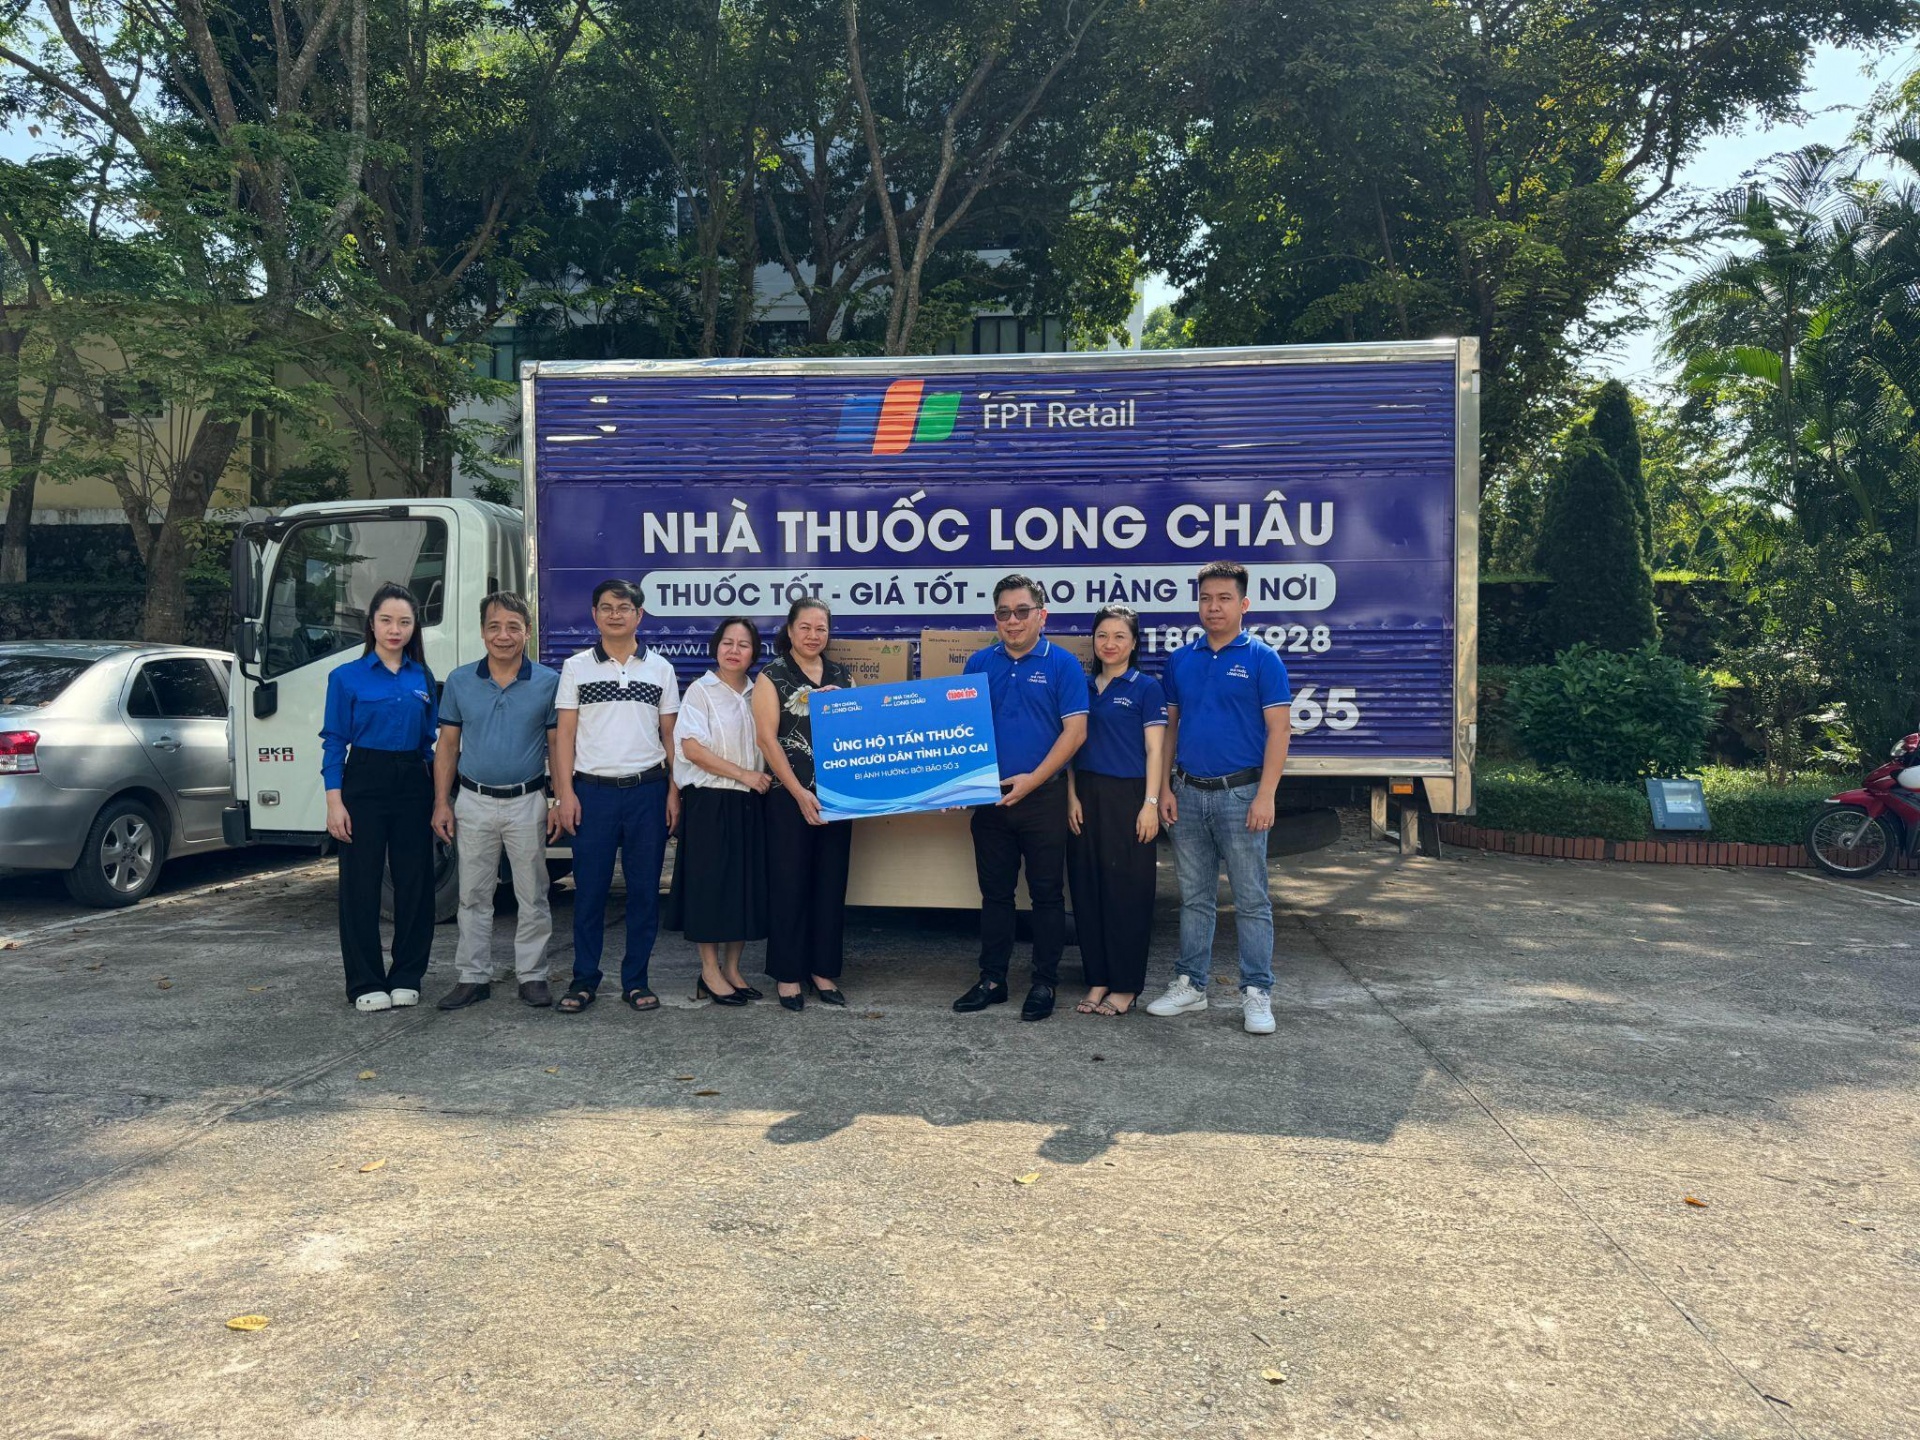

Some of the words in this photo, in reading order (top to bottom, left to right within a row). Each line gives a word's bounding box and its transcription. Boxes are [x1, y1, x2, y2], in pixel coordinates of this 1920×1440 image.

[983, 402, 1040, 429] FPT
[1048, 399, 1135, 428] Retail
[643, 498, 761, 553] NHÀ
[777, 490, 970, 553] THUỐC
[990, 505, 1147, 550] LONG
[1166, 490, 1334, 549] CHÂU
[656, 572, 761, 606] THUỐC
[770, 572, 824, 606] TỐT
[850, 575, 905, 605] GIÁ
[914, 571, 969, 605] TỐT
[1086, 572, 1178, 602] HÀNG
[1259, 573, 1317, 601] NƠI
[859, 661, 880, 673] clorid
[893, 699, 910, 707] LONG
[258, 747, 293, 755] QKR
[832, 737, 863, 752] ỦNG
[865, 734, 886, 749] HỘ
[888, 735, 894, 746] 1
[896, 729, 924, 744] TẤN
[926, 724, 975, 741] THUỐC
[258, 754, 294, 762] 210
[822, 759, 847, 770] CHO
[849, 753, 886, 767] NGƯỜI
[888, 750, 913, 762] DÂN
[944, 744, 967, 756] LÀO
[969, 742, 989, 753] CAI
